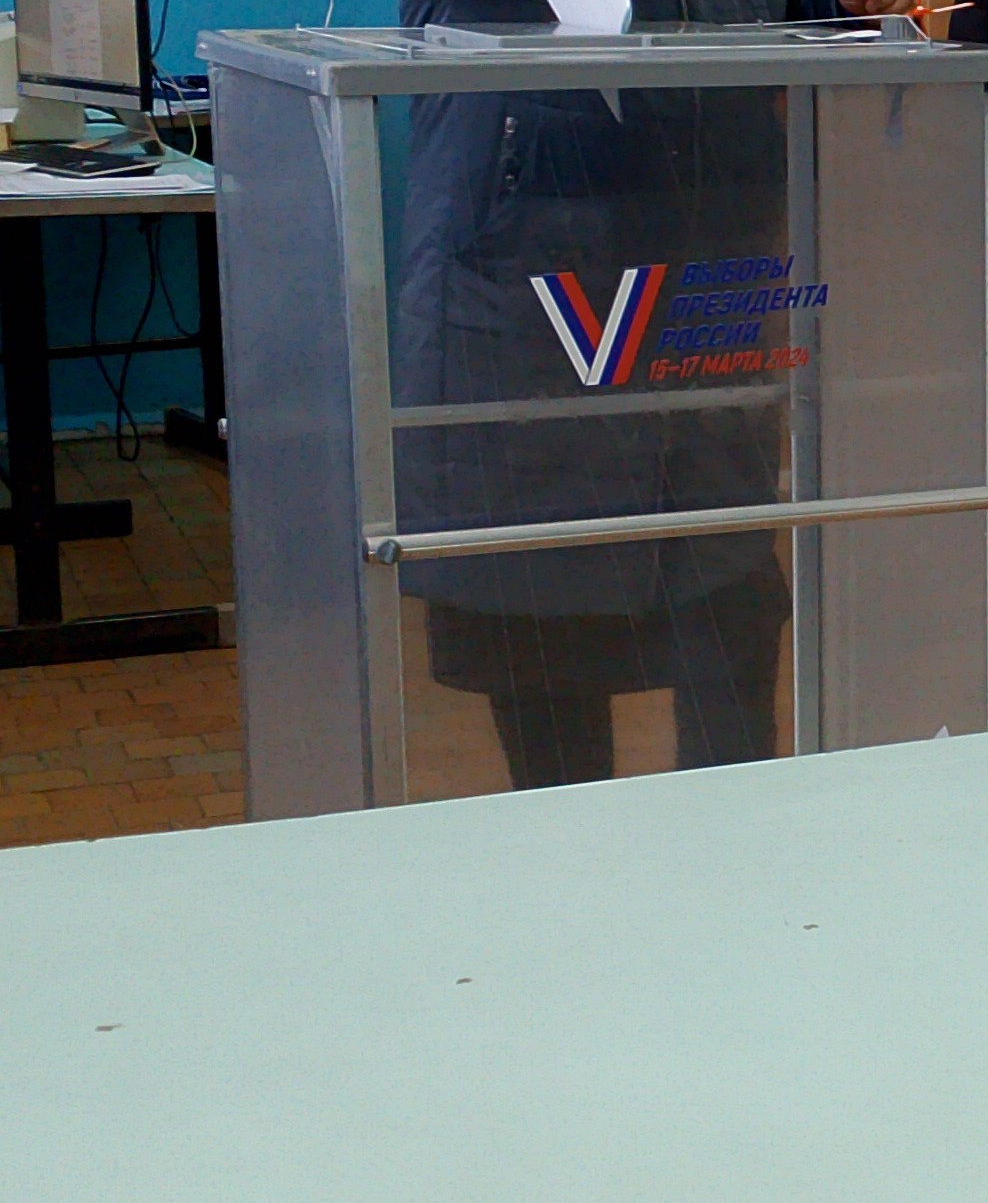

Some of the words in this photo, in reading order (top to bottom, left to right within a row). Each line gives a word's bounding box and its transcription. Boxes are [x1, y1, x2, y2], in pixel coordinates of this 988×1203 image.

[681, 255, 795, 286] ВЫБОРЫ
[668, 284, 829, 321] ПРЕЗИДЕНТА
[656, 321, 763, 353] РОССИИ
[702, 350, 765, 377] МАРТА
[765, 347, 810, 371] 2024
